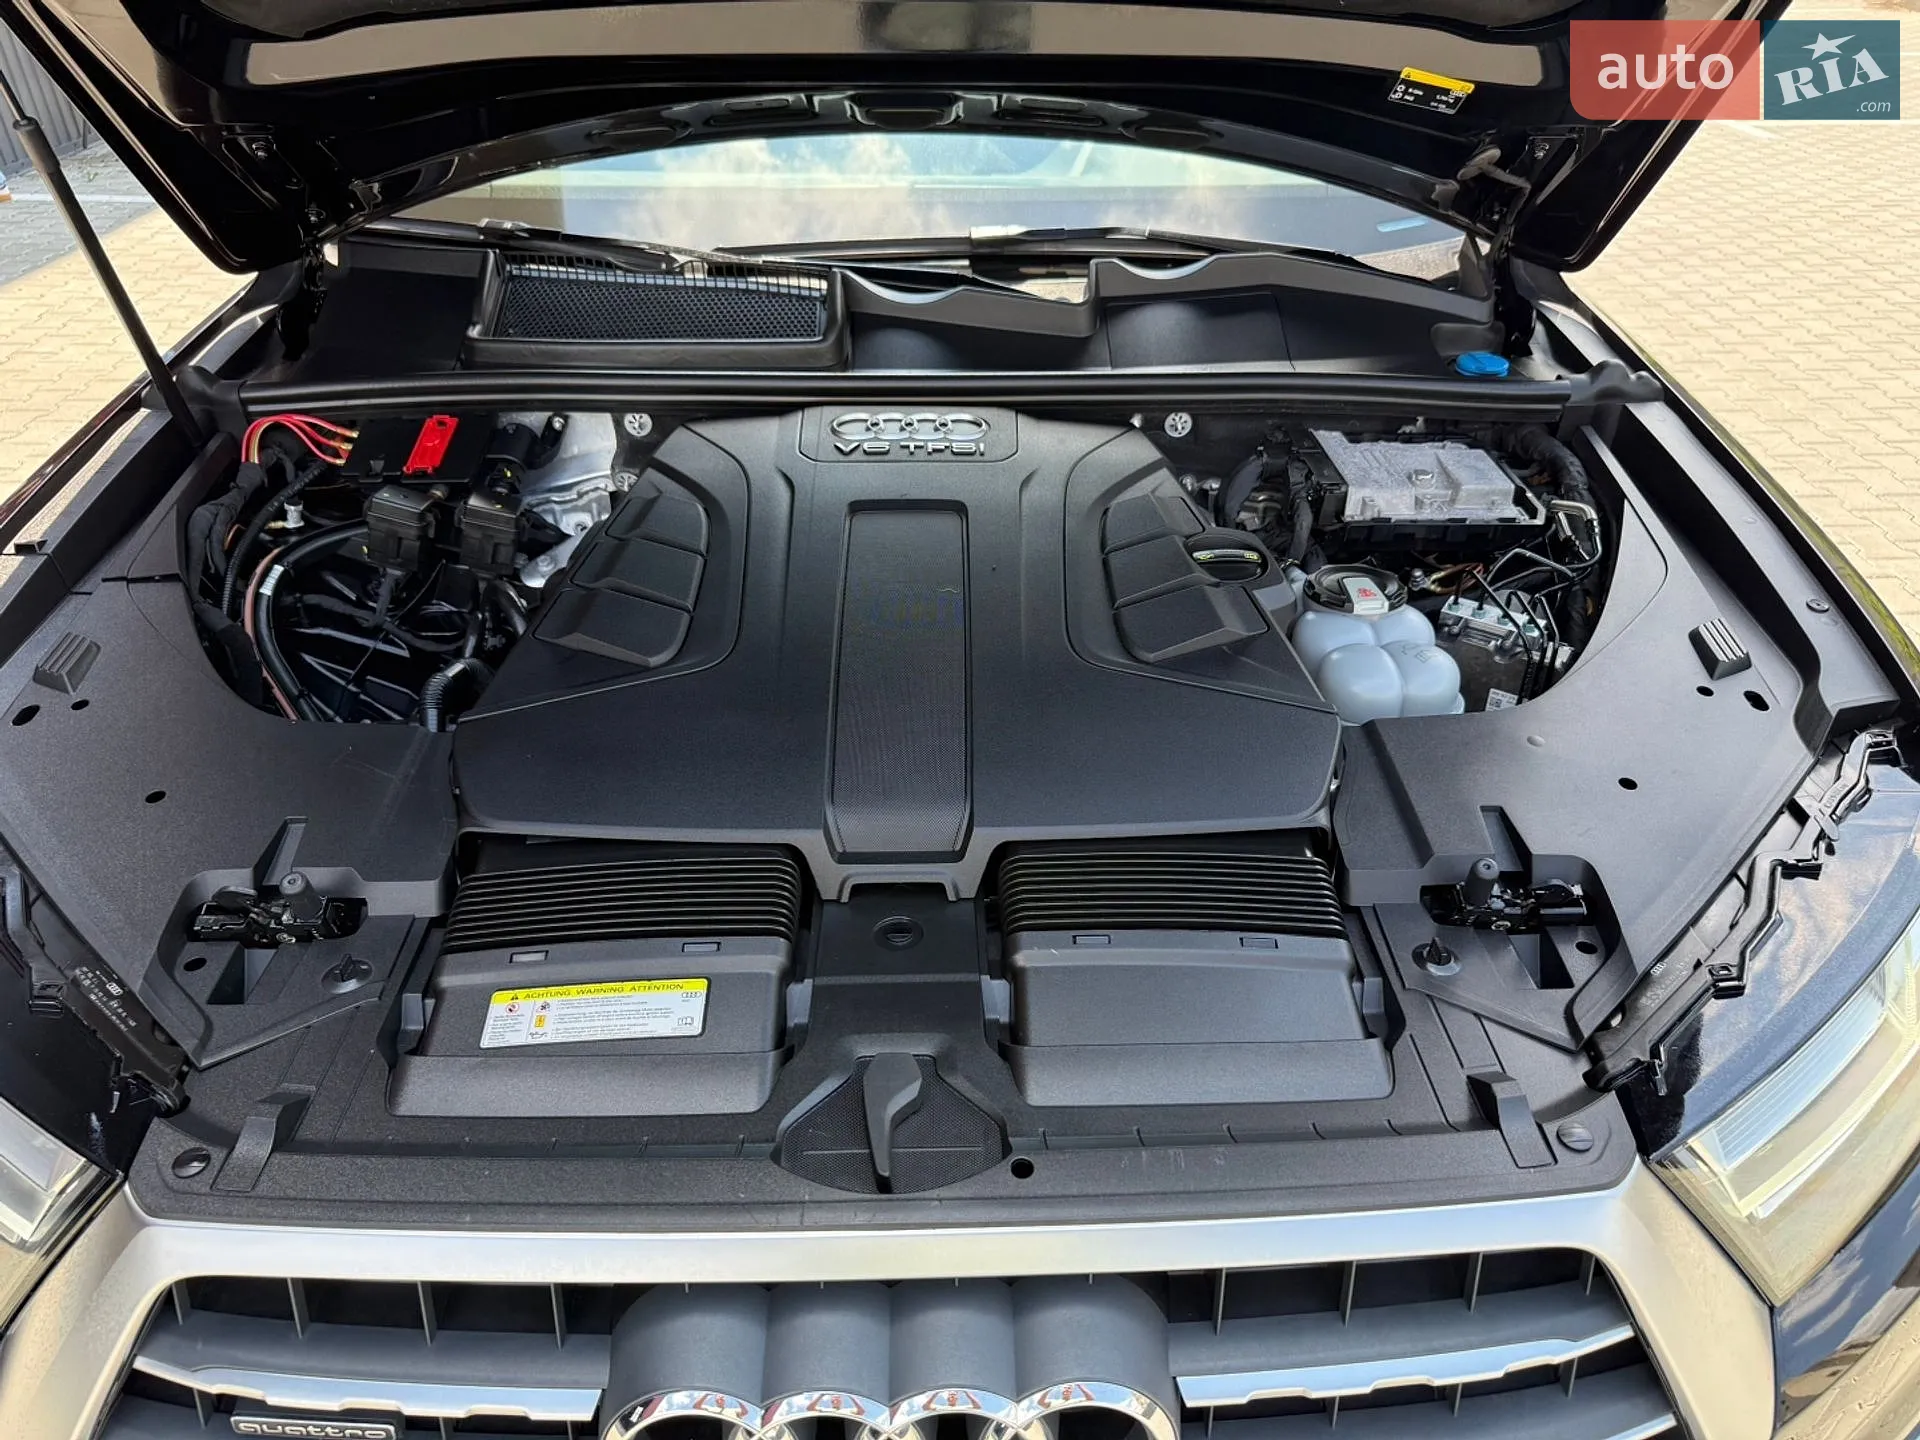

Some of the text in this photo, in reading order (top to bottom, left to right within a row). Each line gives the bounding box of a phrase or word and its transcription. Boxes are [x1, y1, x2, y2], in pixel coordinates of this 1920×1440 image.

[833, 441, 891, 456] V6
[523, 983, 684, 999] ACHTUNG WARNING ATTENTION
[238, 1422, 387, 1439] quattro
